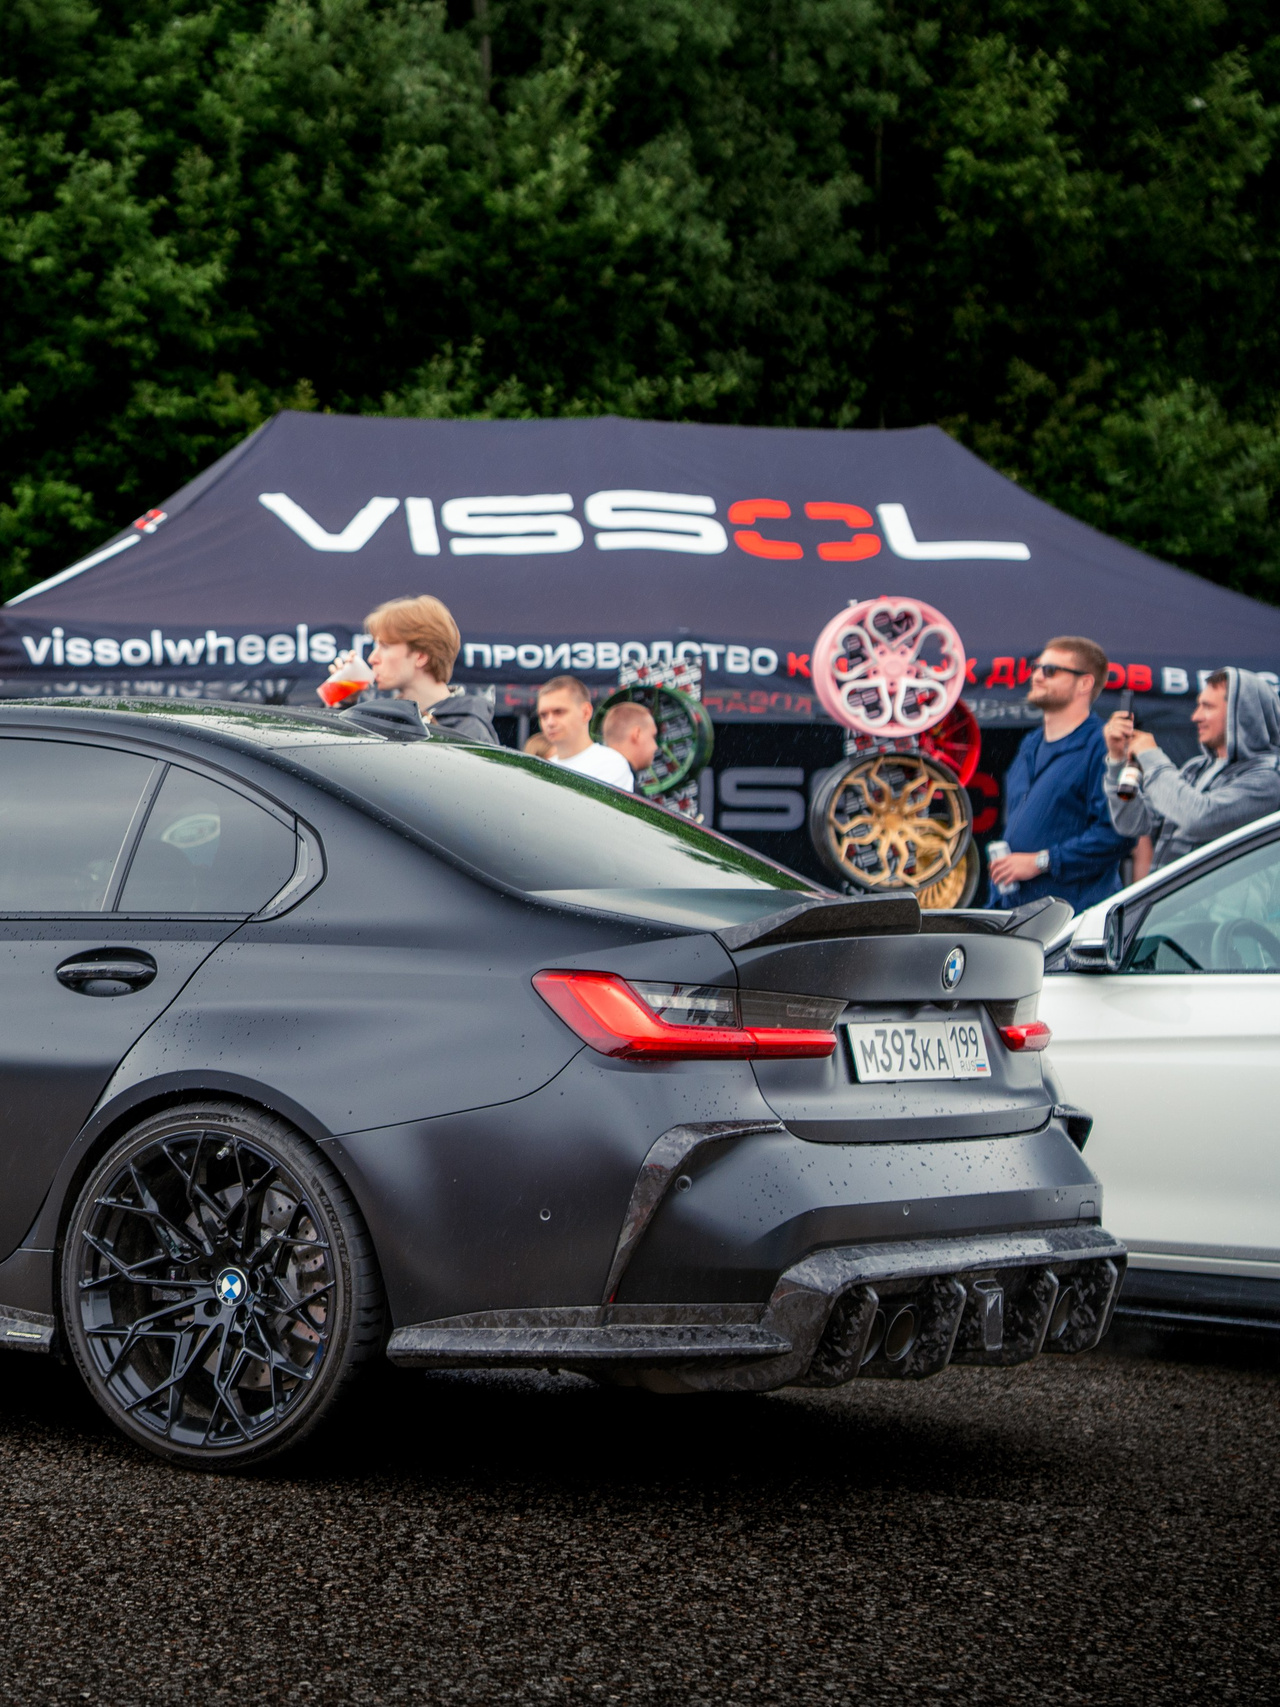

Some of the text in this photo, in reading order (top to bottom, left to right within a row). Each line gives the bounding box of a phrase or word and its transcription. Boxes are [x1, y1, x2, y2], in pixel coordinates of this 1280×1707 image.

[257, 489, 1032, 562] VISSOL
[21, 623, 374, 668] vissolwheels.r
[949, 1025, 979, 1058] 199
[960, 1060, 977, 1072] RUS
